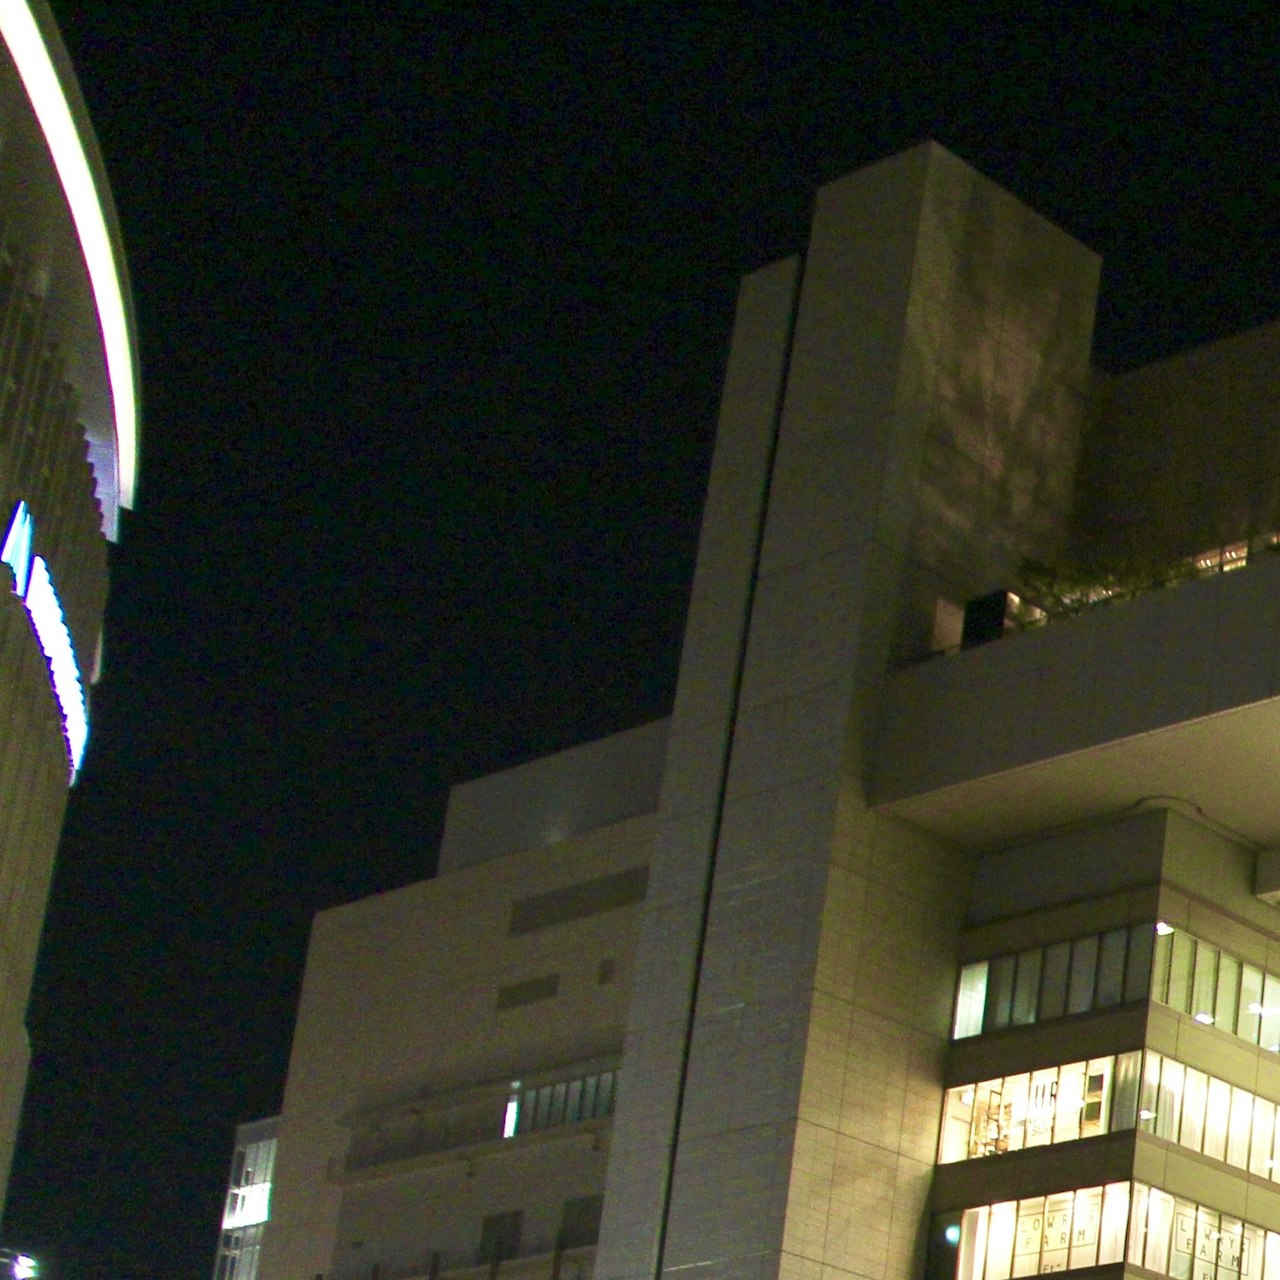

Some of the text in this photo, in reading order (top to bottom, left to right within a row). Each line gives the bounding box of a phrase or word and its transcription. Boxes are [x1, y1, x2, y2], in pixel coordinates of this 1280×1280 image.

[1020, 1208, 1095, 1233] LOWRS
[1025, 1229, 1086, 1251] FARM
[1186, 1238, 1241, 1268] FARM
